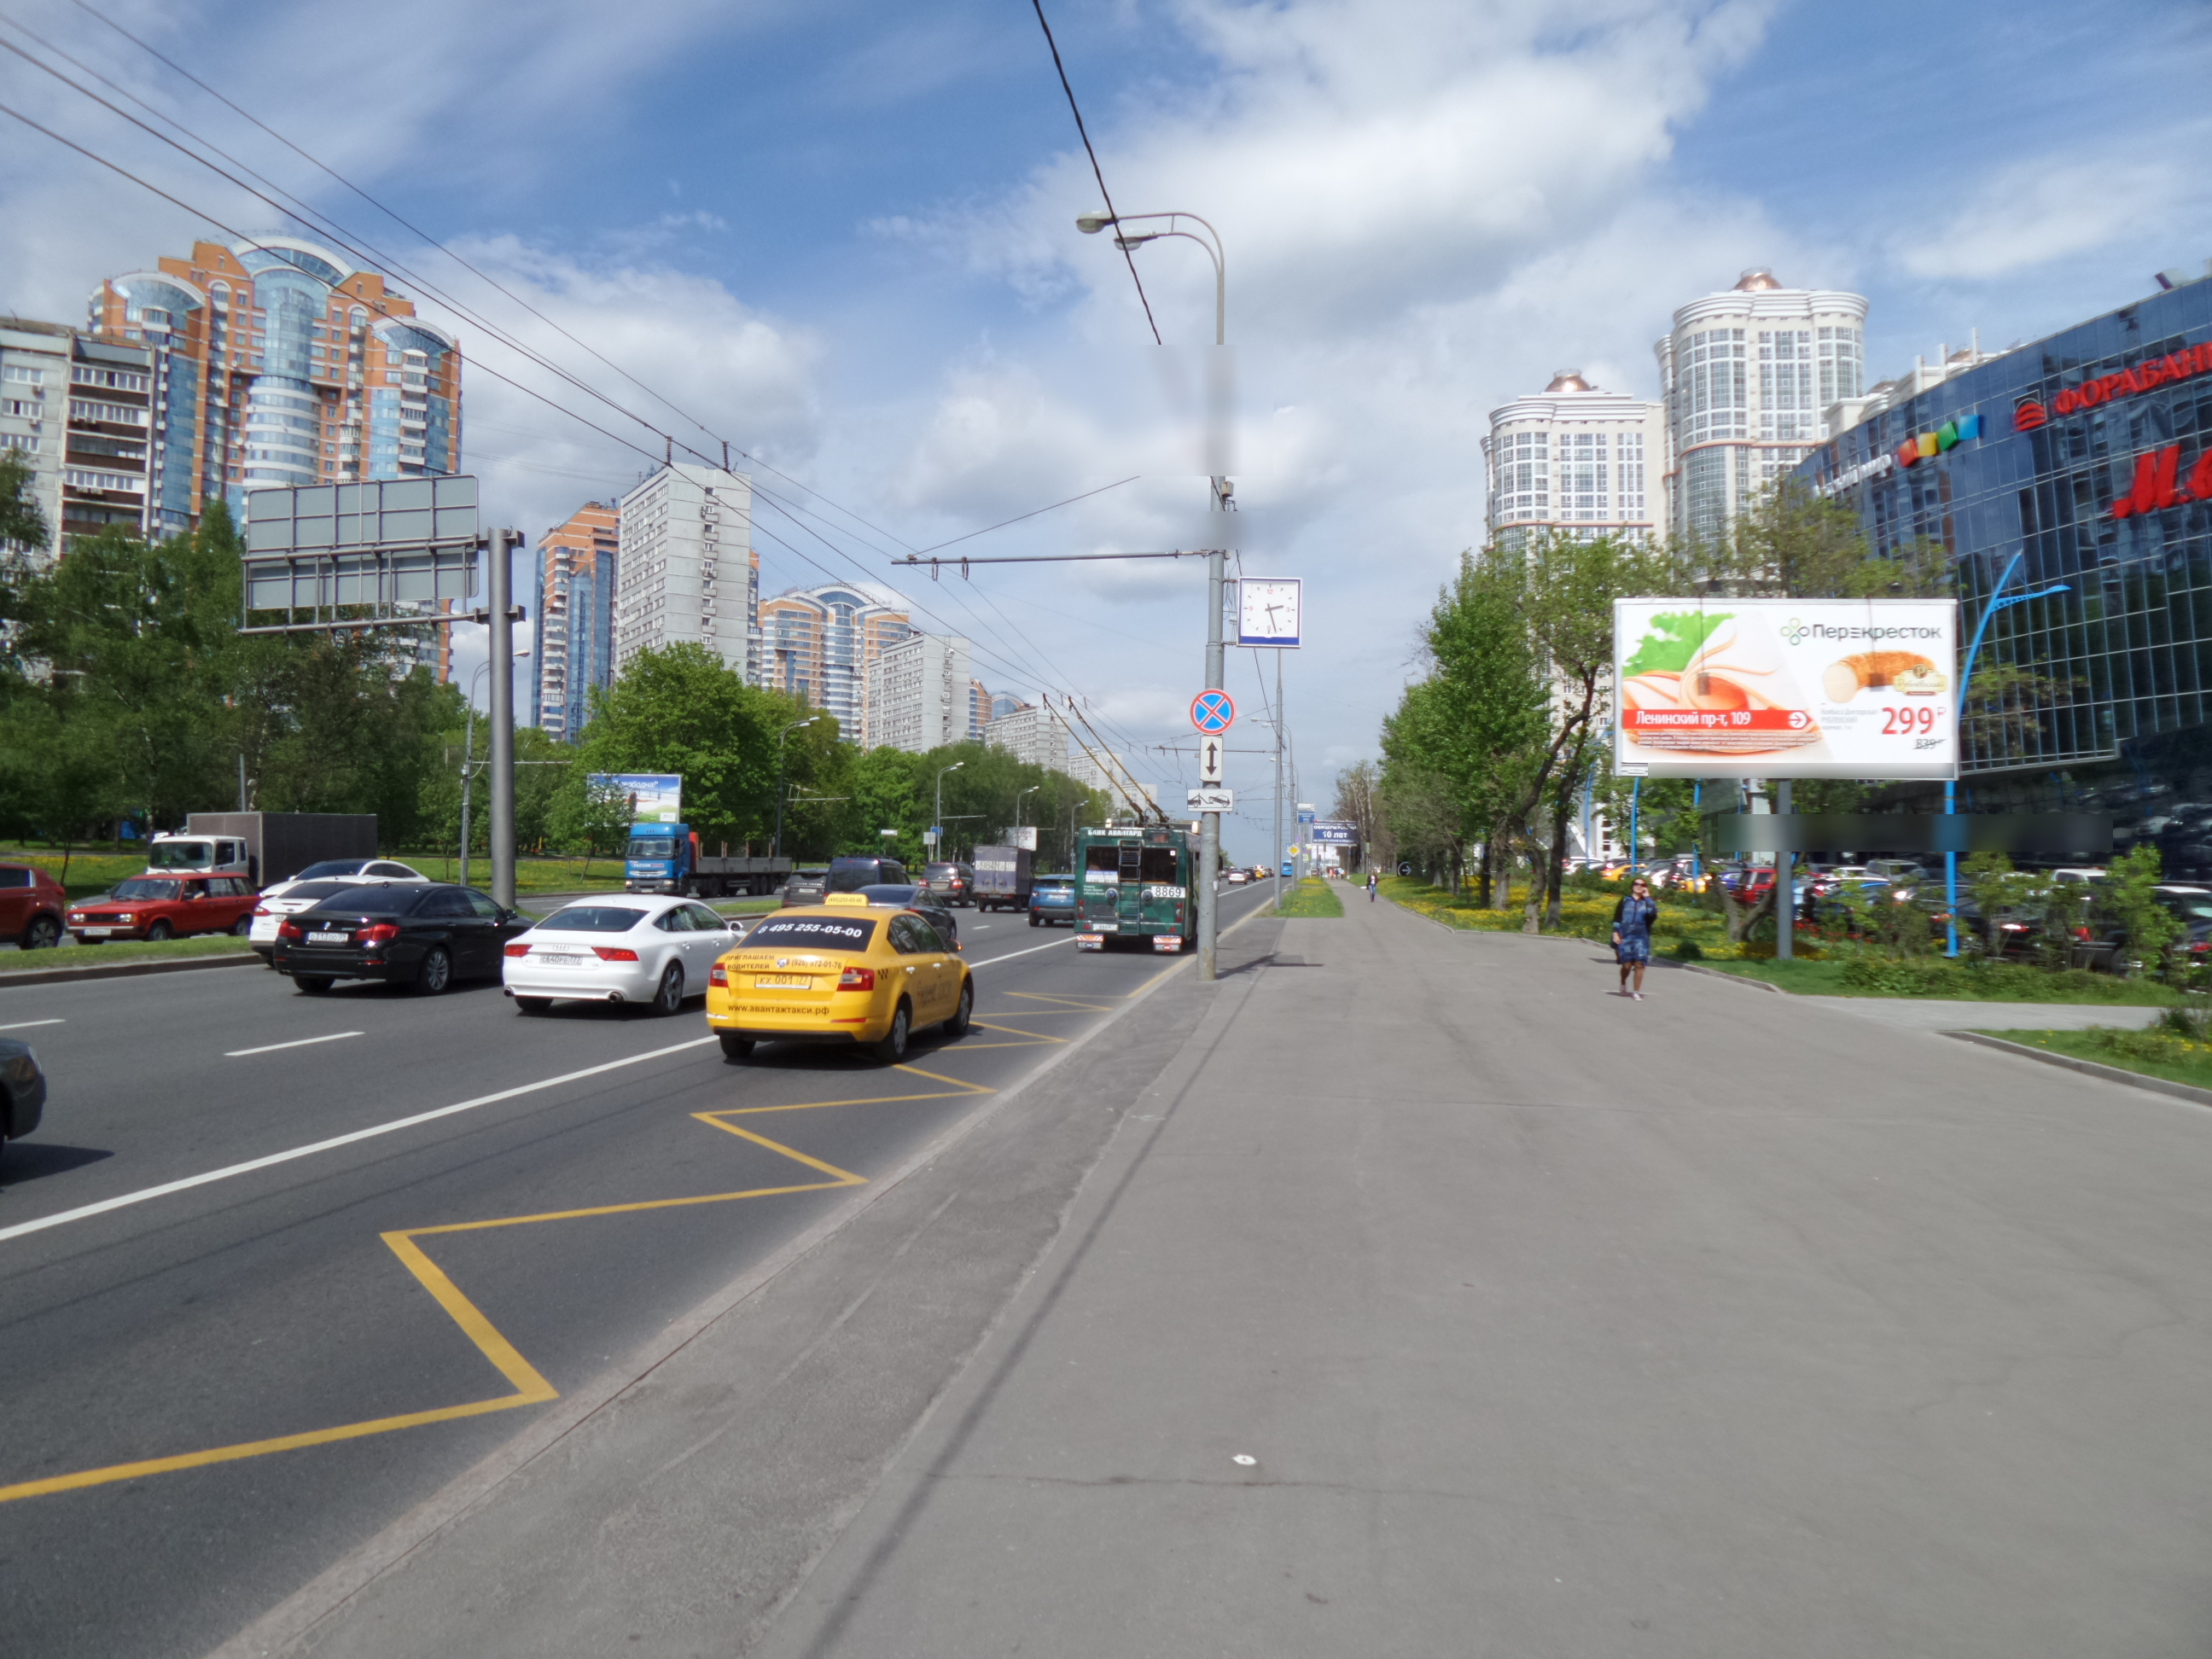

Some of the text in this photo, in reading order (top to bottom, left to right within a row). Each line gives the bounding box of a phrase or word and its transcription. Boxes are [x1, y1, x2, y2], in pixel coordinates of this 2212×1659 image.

[1813, 624, 1942, 642] Перекресток
[1636, 710, 1751, 727] Ленинский пр-т, 109
[1882, 707, 1936, 735] 299
[1155, 887, 1182, 897] 8869
[758, 923, 863, 938] 8 495 255-05-00
[727, 1004, 830, 1016] www.авантажтакси.рф
